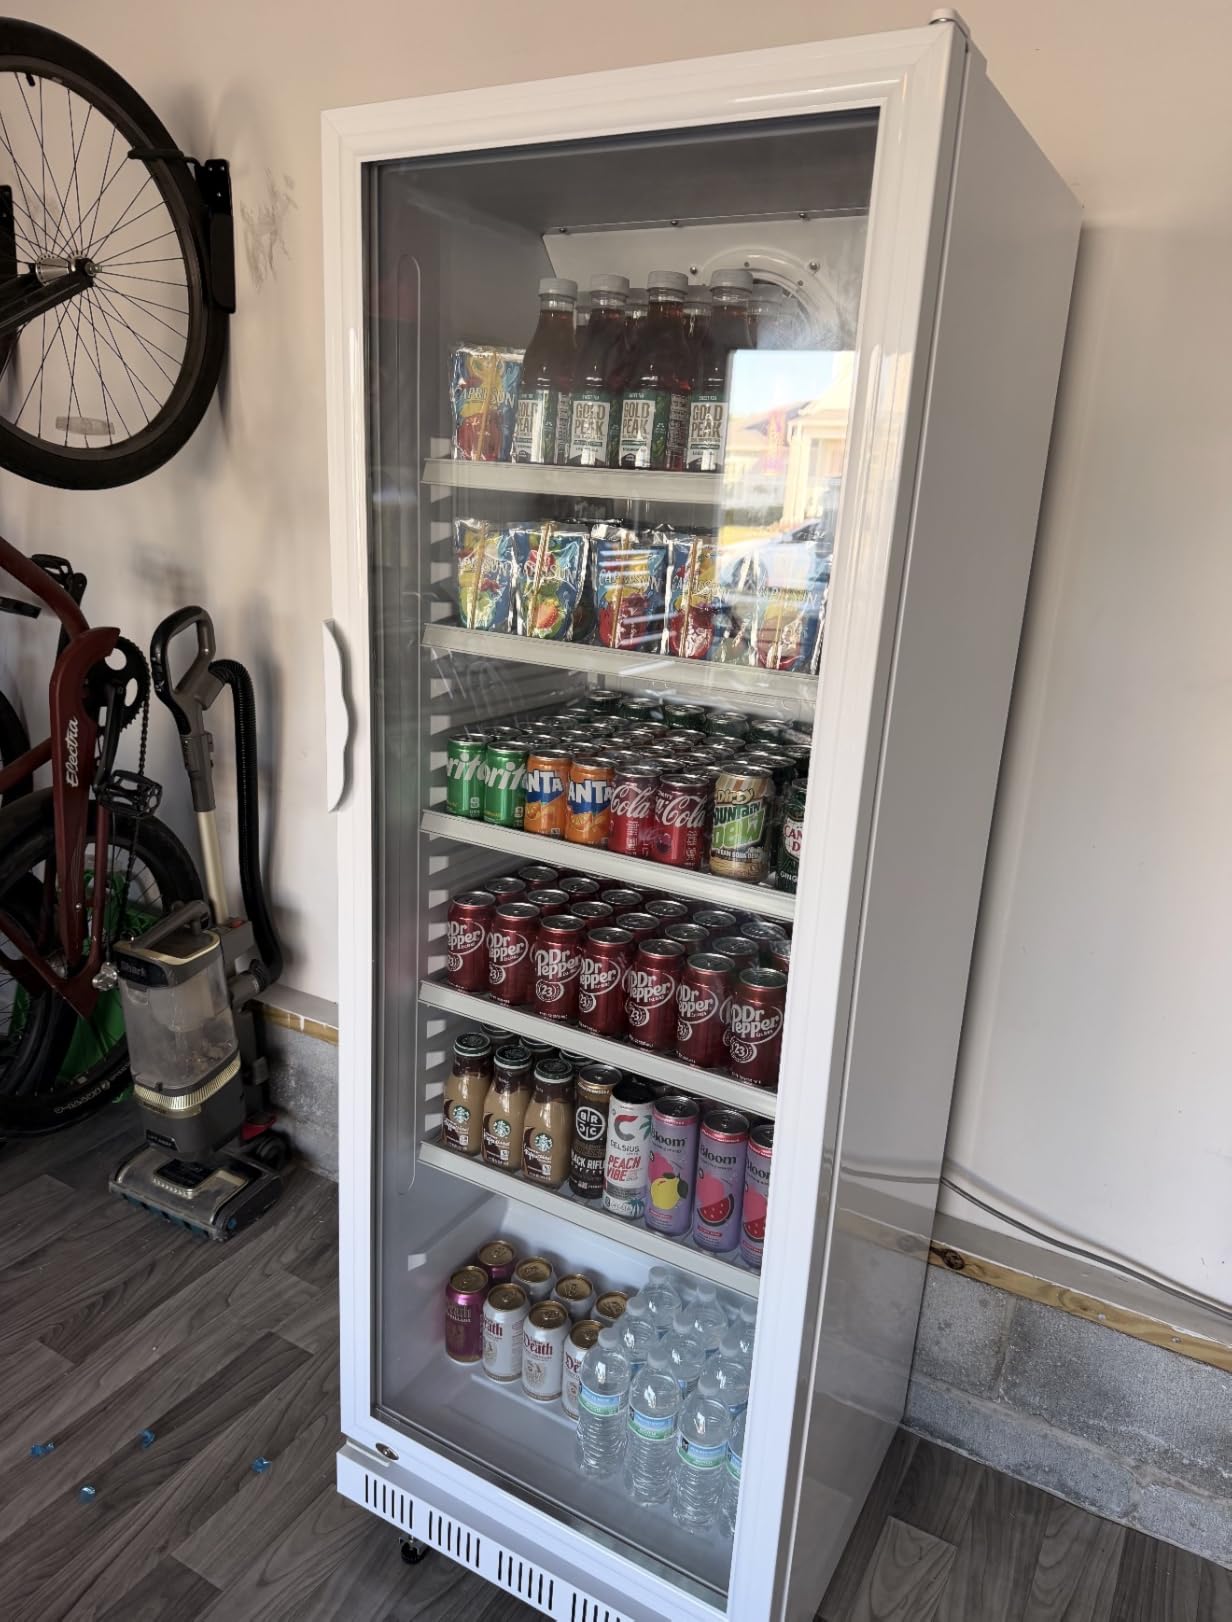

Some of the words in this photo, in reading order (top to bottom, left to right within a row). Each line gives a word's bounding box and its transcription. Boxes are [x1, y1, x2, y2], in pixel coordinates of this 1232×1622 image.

[623, 402, 650, 419] GOLD
[692, 404, 723, 421] GOLD
[622, 419, 649, 436] PEAK
[691, 420, 722, 438] PEAK
[65, 715, 79, 788] Electra
[527, 769, 564, 794] NTA
[568, 779, 613, 804] ANTA
[783, 824, 803, 841] CAN
[780, 870, 798, 883] GING
[450, 921, 468, 936] Dr
[493, 933, 511, 947] Dr
[549, 949, 571, 964] Dr
[584, 958, 602, 973] Dr
[637, 971, 657, 987] Dr
[542, 985, 554, 997] 23
[682, 985, 699, 999] Dr
[731, 1003, 780, 1038] Pepper
[742, 1005, 765, 1022] Dr
[735, 1043, 745, 1057] 23
[610, 1139, 640, 1153] CELSIUS
[587, 1160, 605, 1170] RIFL
[608, 1154, 642, 1169] PEACH
[745, 1158, 770, 1179] loo
[606, 1168, 628, 1182] VIBE
[523, 1332, 553, 1356] Death
